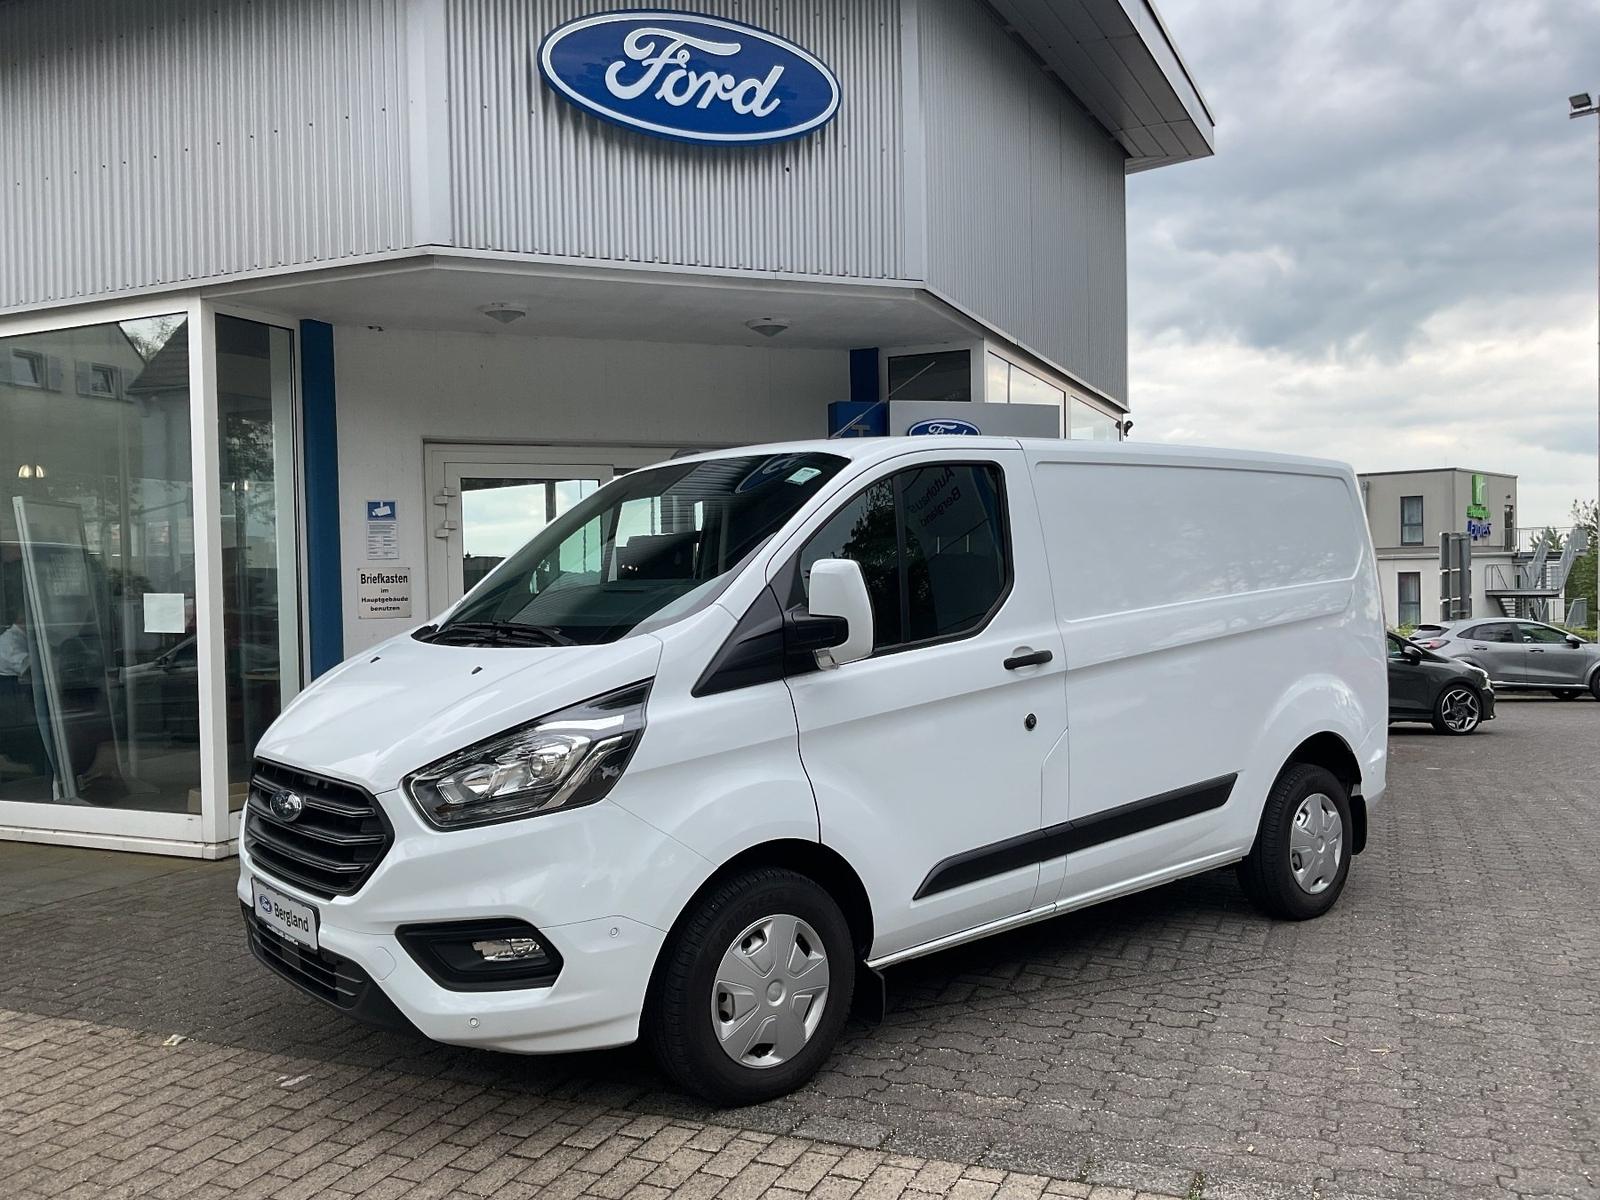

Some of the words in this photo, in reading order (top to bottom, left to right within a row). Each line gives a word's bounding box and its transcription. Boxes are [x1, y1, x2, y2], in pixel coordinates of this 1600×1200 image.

[604, 27, 784, 118] Ford
[360, 573, 408, 584] Briefkasten
[274, 902, 309, 933] Bergland
